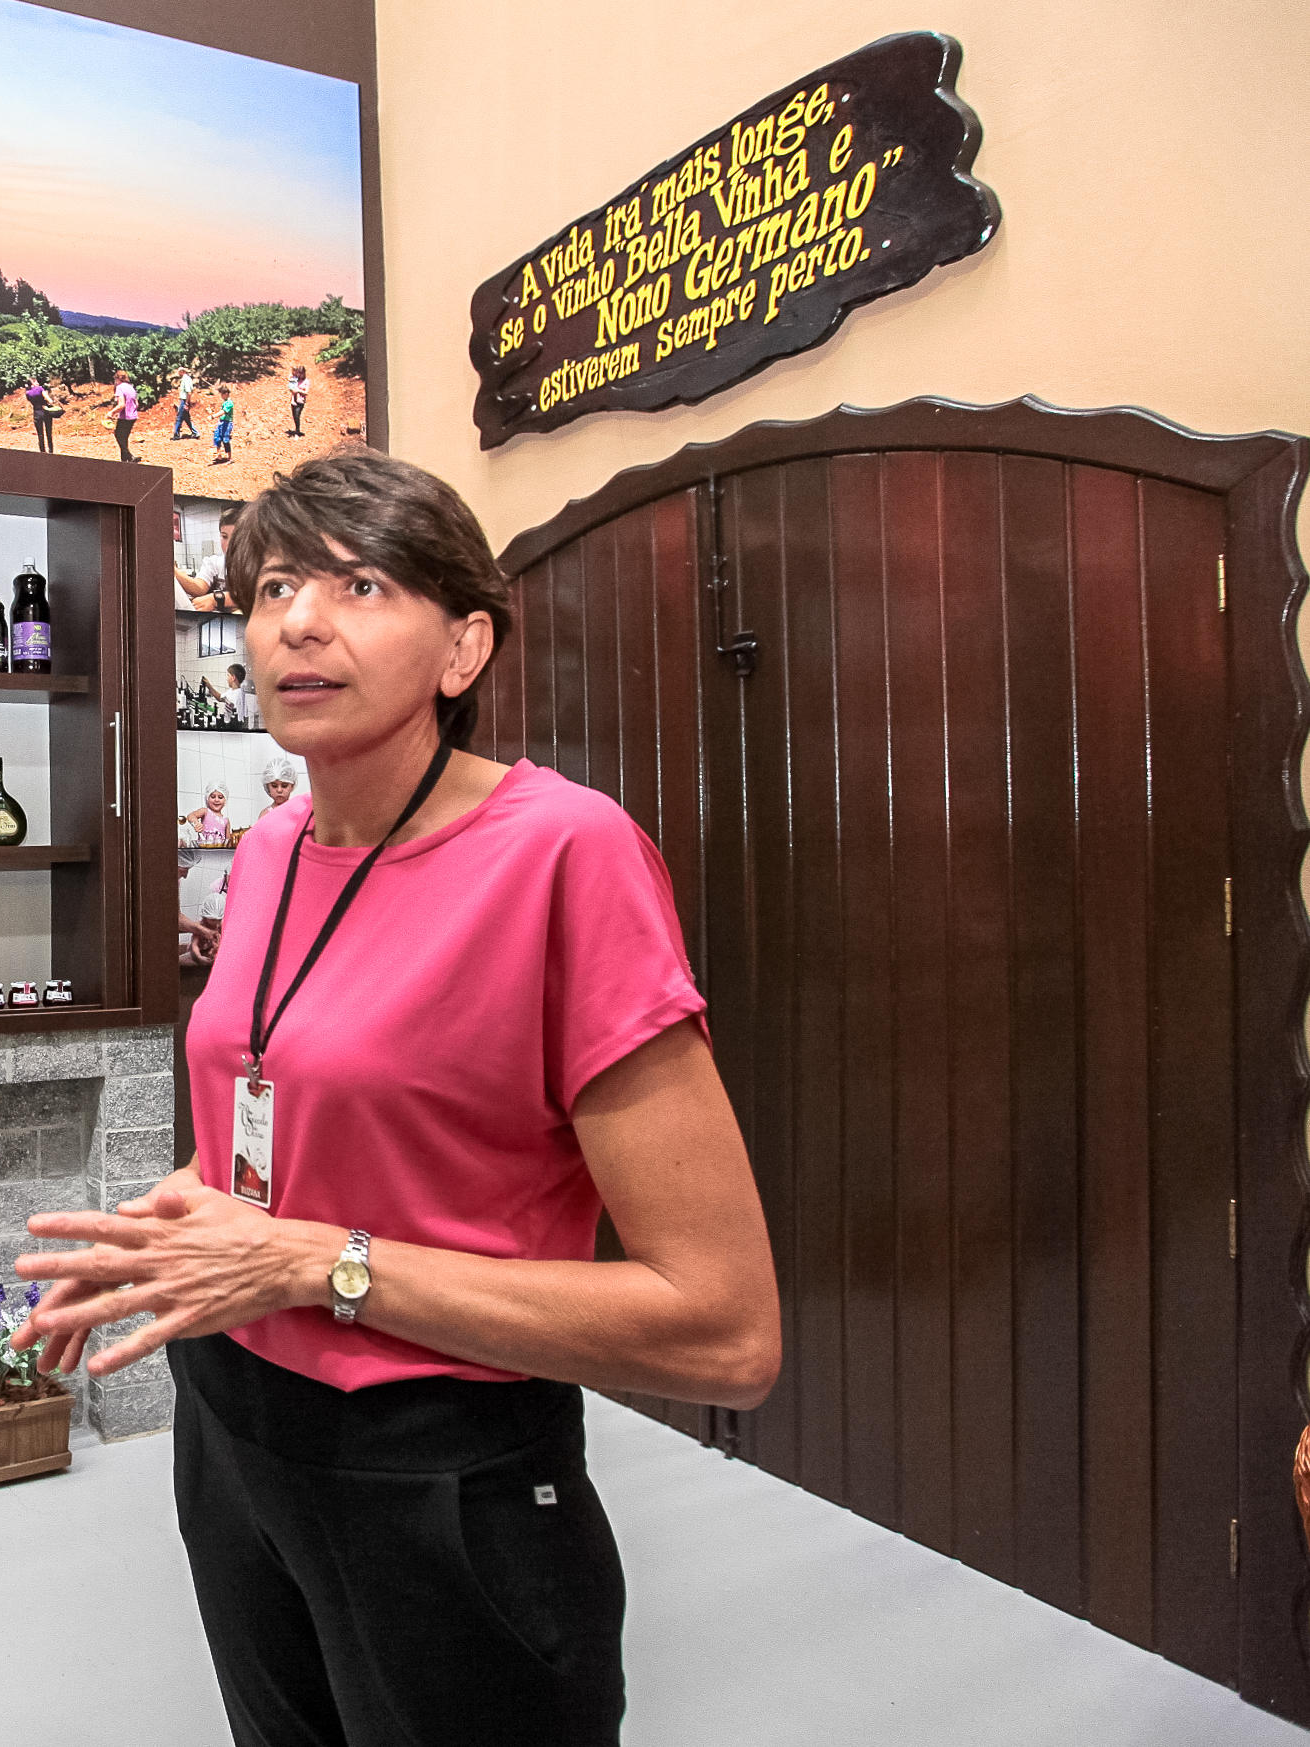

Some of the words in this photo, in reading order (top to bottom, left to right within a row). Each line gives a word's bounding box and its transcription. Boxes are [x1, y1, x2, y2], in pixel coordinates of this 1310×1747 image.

[500, 316, 525, 358] se
[533, 303, 548, 334] o
[709, 148, 811, 229] Vinha
[828, 123, 854, 174] e
[520, 261, 543, 309] A
[650, 142, 722, 227] mais
[727, 82, 836, 178] longe,
[540, 341, 641, 413] estiverem
[655, 278, 757, 363] sempre
[763, 226, 872, 325] perto.
[594, 273, 672, 349] Nono
